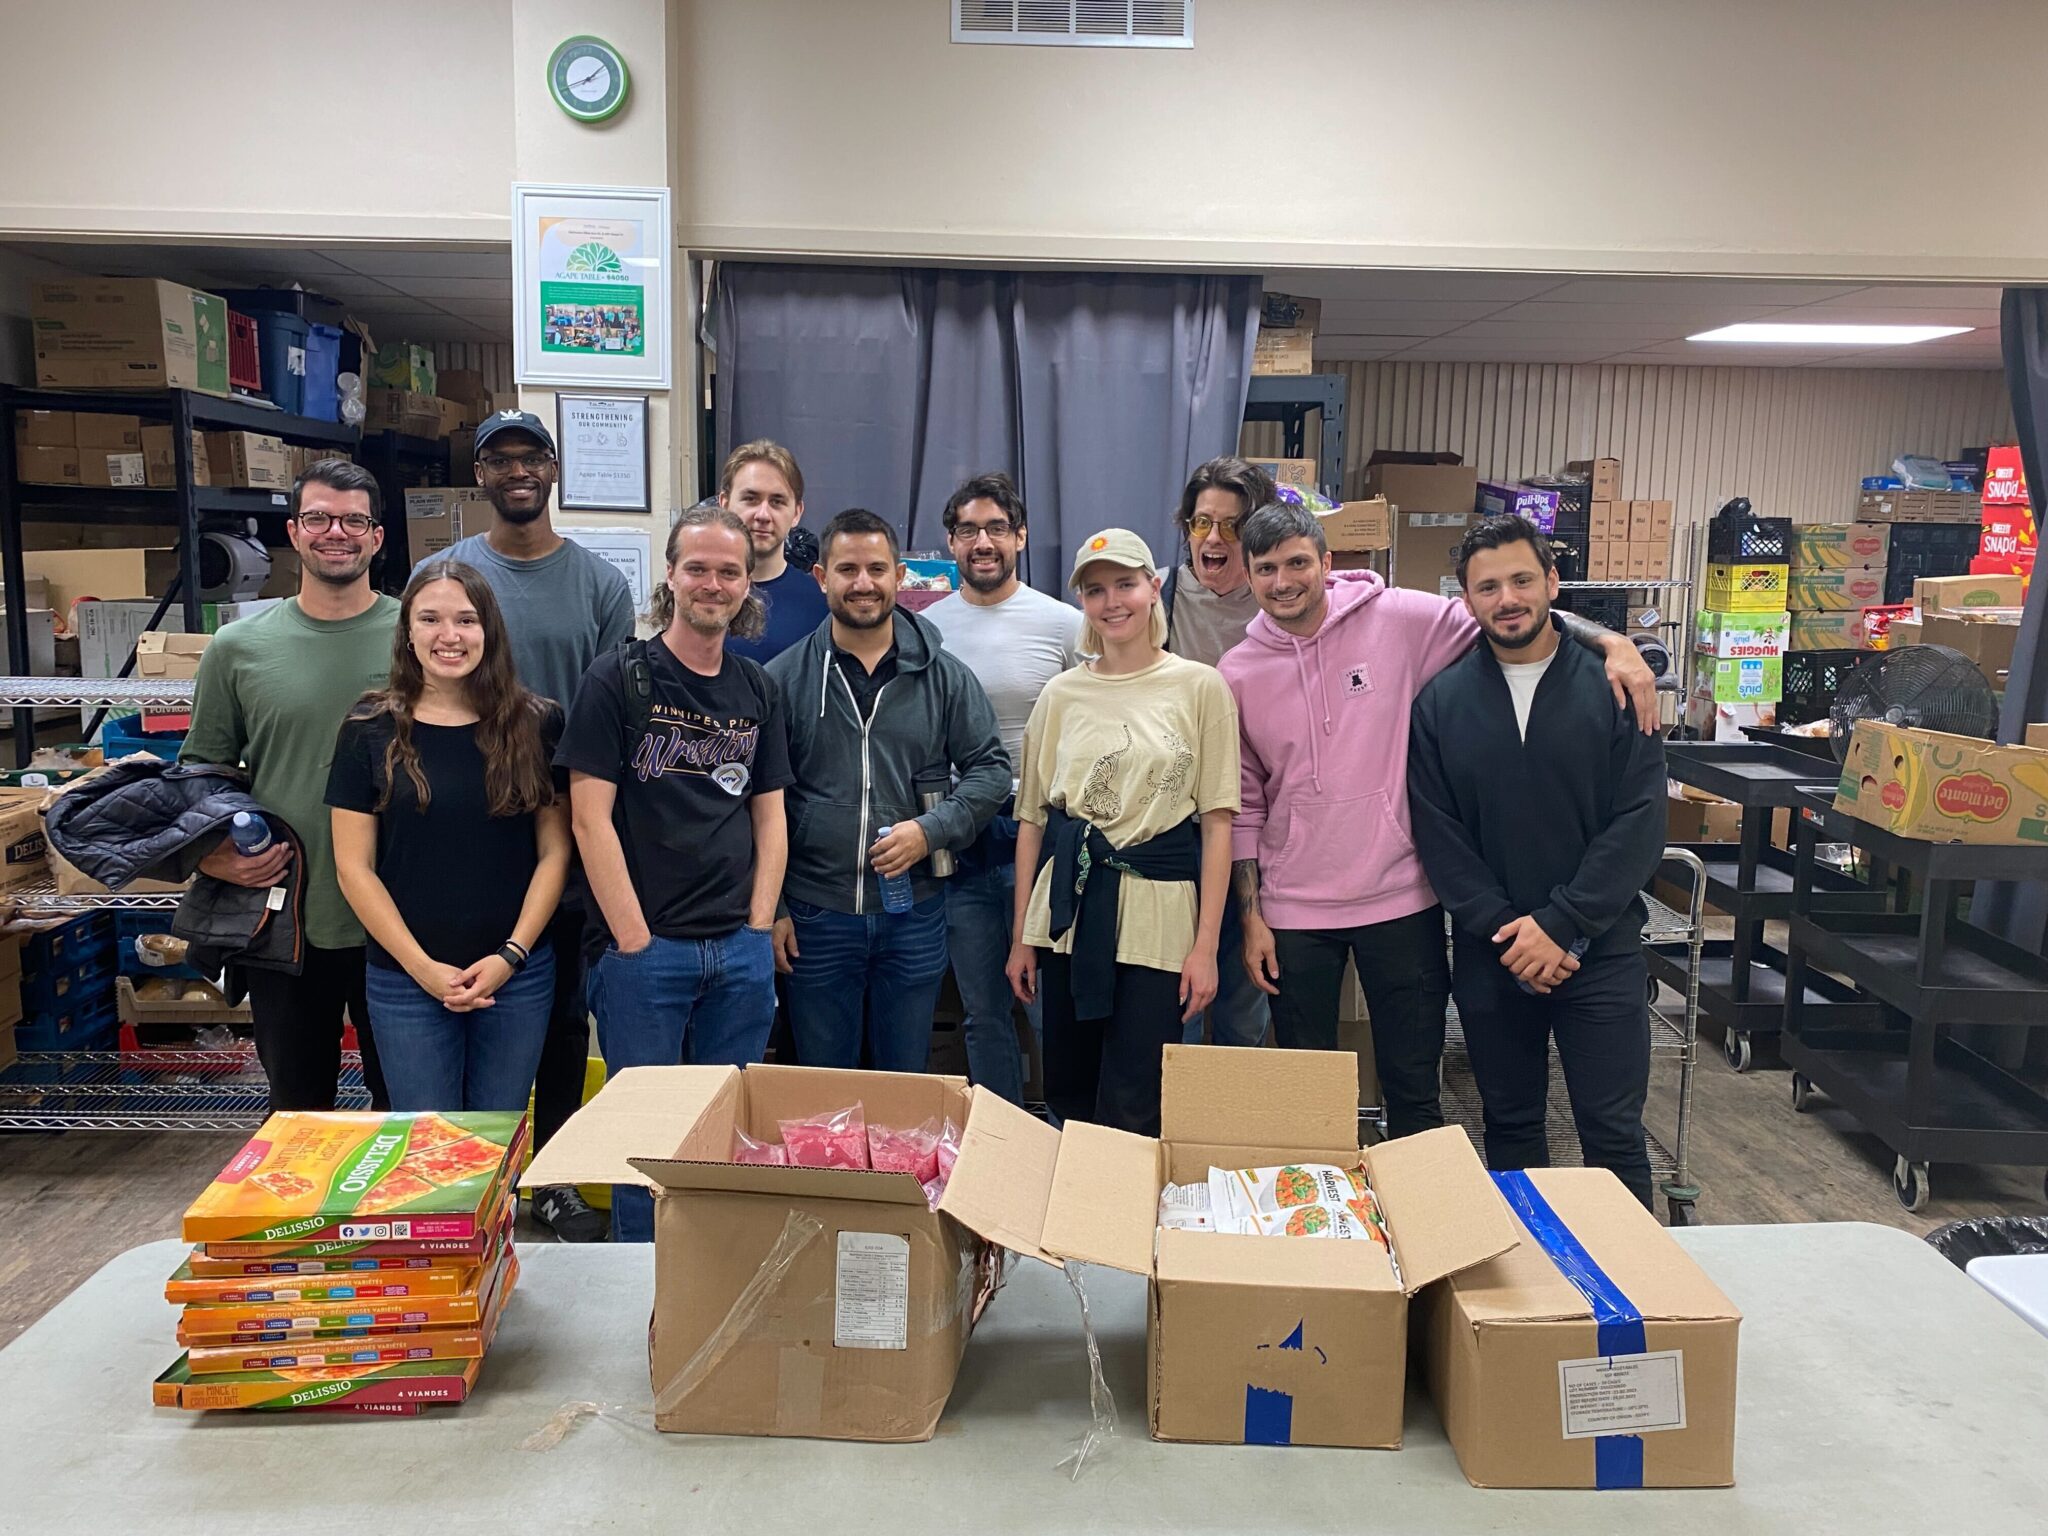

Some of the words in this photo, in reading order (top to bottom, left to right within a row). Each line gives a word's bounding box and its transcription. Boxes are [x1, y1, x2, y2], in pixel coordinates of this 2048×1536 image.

[581, 272, 600, 280] TABLE
[571, 412, 633, 421] STRENGTHENING
[129, 472, 144, 484] 145
[1730, 645, 1779, 656] HUGGIES
[652, 704, 720, 728] WINNIPEG
[1940, 787, 1980, 807] Monte
[1981, 793, 2004, 810] Del
[339, 1134, 404, 1193] DELISSIO
[1322, 1170, 1341, 1202] HARVEST
[264, 1216, 325, 1240] DELISSIO
[206, 1385, 230, 1396] MINCE
[290, 1380, 352, 1404] DELISSIO
[191, 1395, 239, 1407] CROUSTILLANTE
